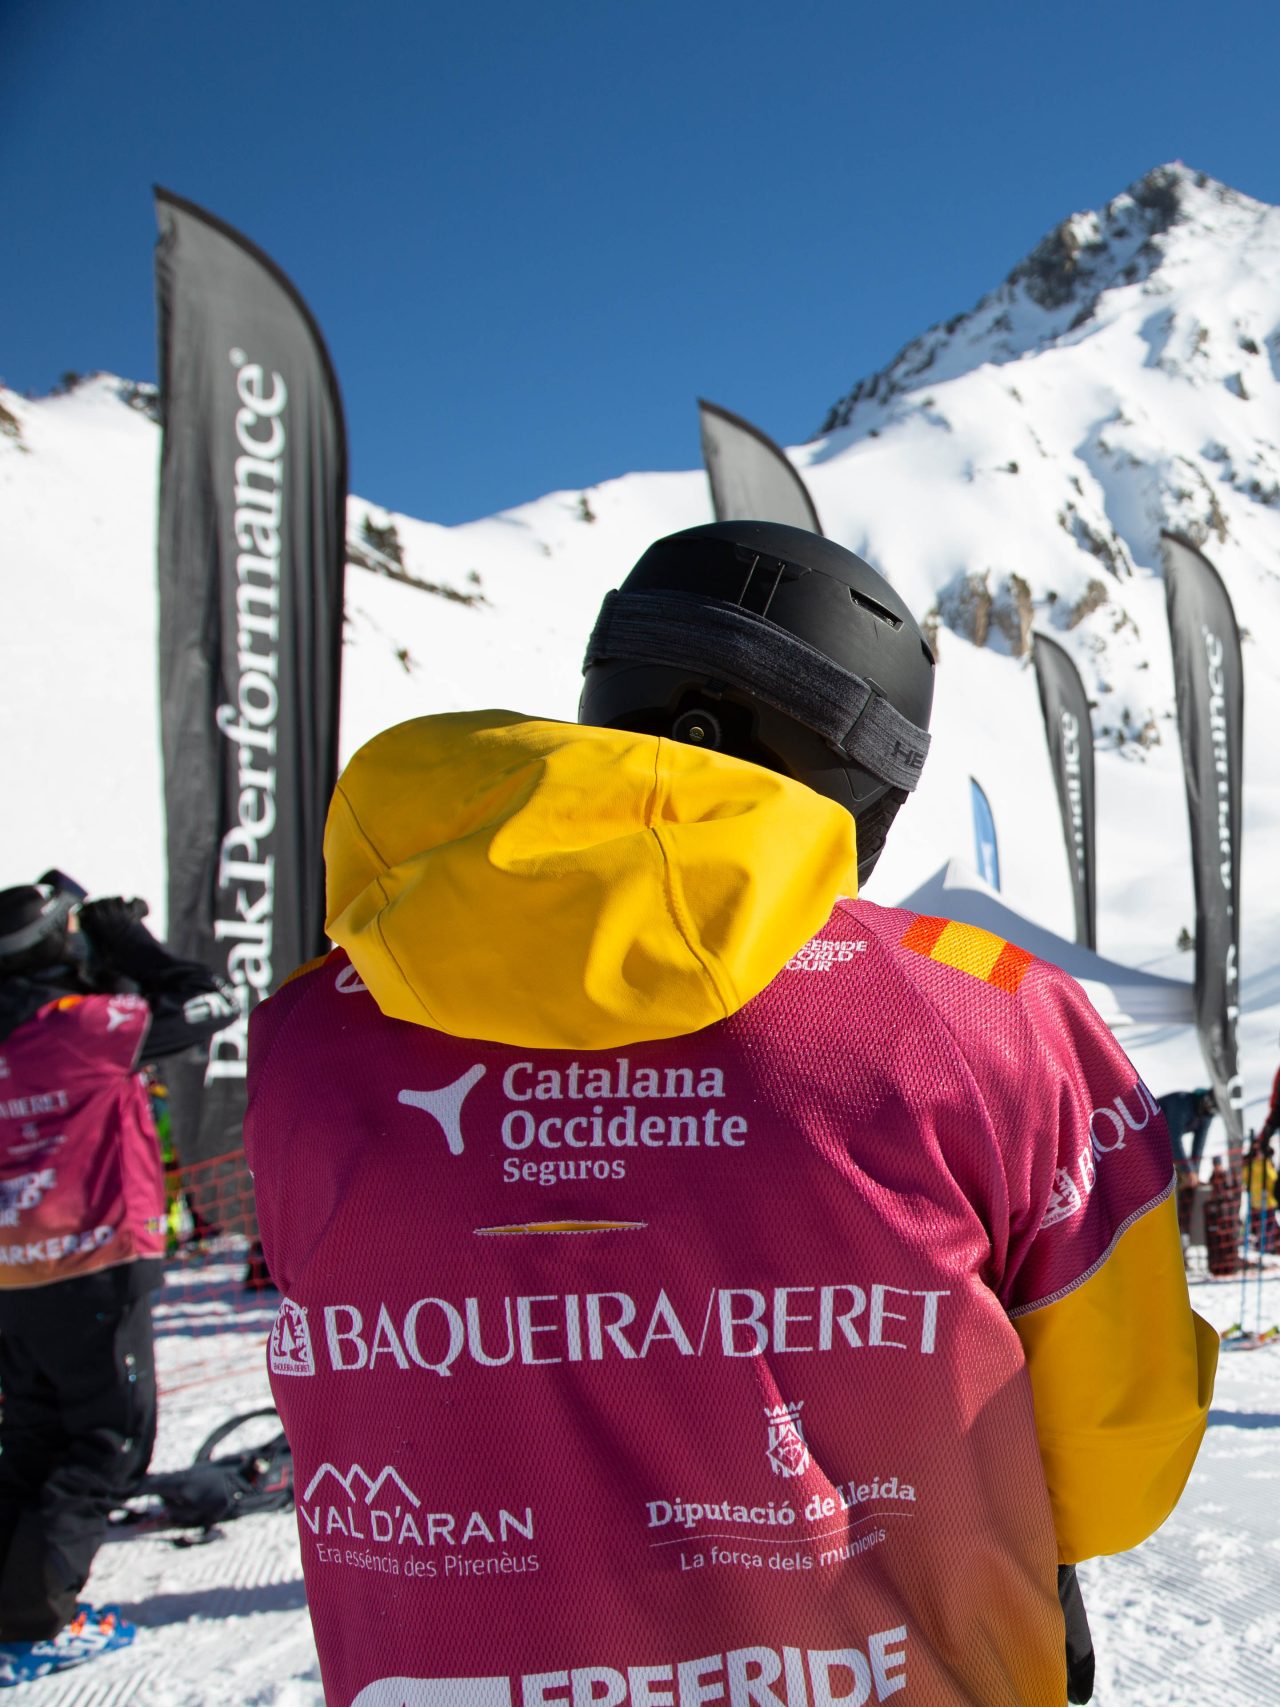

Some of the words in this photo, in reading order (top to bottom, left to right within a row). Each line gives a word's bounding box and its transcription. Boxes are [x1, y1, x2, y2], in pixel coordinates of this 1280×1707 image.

[893, 740, 925, 770] HE
[785, 959, 833, 972] OUR
[796, 950, 854, 962] ORLD
[502, 1058, 726, 1101] Catalana
[0, 1089, 68, 1119] BERET
[501, 1105, 748, 1150] Occidente
[503, 1157, 626, 1186] Seguros
[323, 1283, 952, 1378] BAQUEIRA/BERET
[645, 1497, 796, 1529] Diputació
[804, 1494, 836, 1522] de
[836, 1476, 918, 1512] Lleida
[316, 1543, 342, 1564] Era
[404, 1554, 438, 1578] des
[445, 1551, 541, 1577] Pirenèus
[679, 1551, 705, 1571] La
[711, 1546, 763, 1569] força
[768, 1551, 813, 1571] dels
[819, 1525, 887, 1566] municipis
[521, 1624, 909, 1707] FREERIDE
